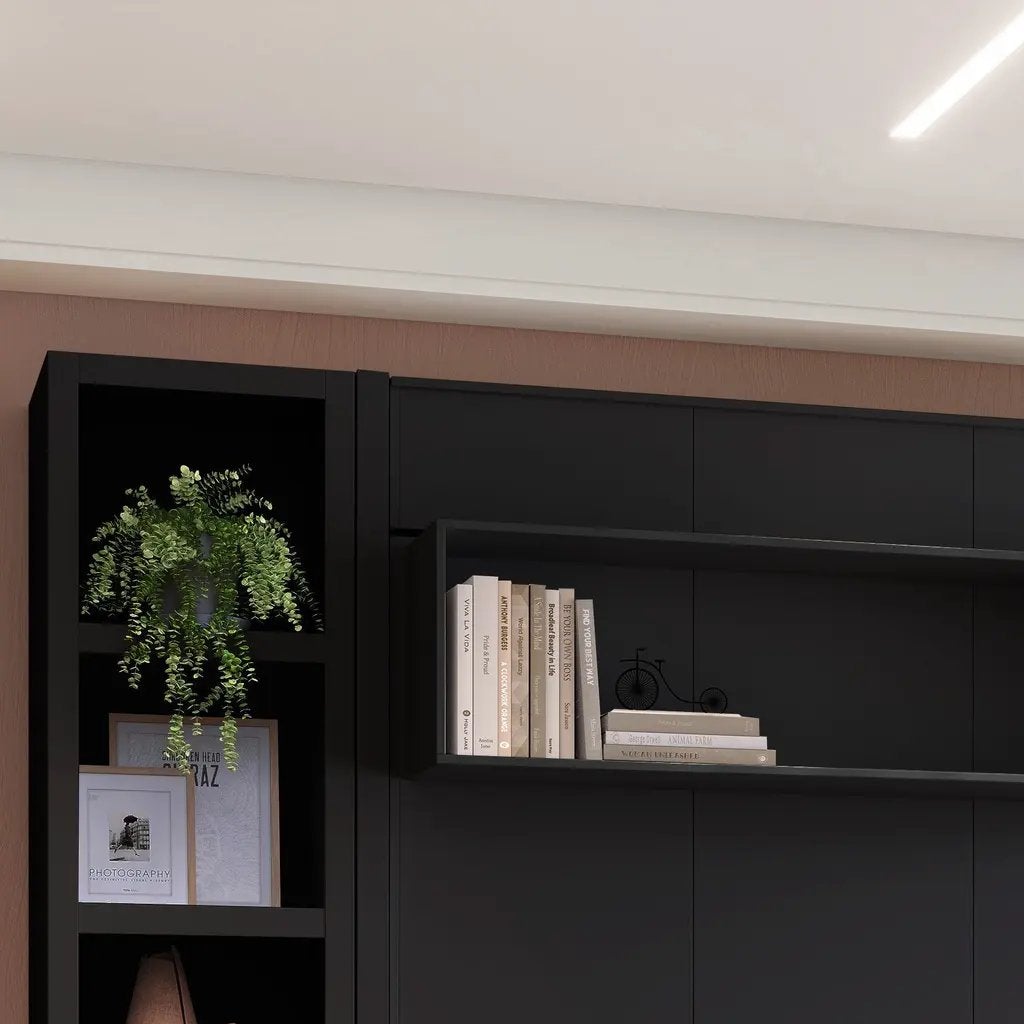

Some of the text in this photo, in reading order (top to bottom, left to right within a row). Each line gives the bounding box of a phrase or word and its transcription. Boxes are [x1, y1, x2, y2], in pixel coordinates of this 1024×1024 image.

[464, 620, 470, 630] LA
[547, 634, 555, 657] Beauty
[563, 604, 572, 682] BE YOUR OWN BOSS
[582, 609, 594, 686] FIND YOUR BEST WAY
[501, 668, 509, 706] CLOCKWORK
[501, 708, 509, 733] ORANGE
[668, 735, 693, 745] ANIMAL
[695, 735, 713, 745] FARM
[202, 751, 221, 763] HEAD
[89, 868, 170, 878] PHOTOGRAPHY
